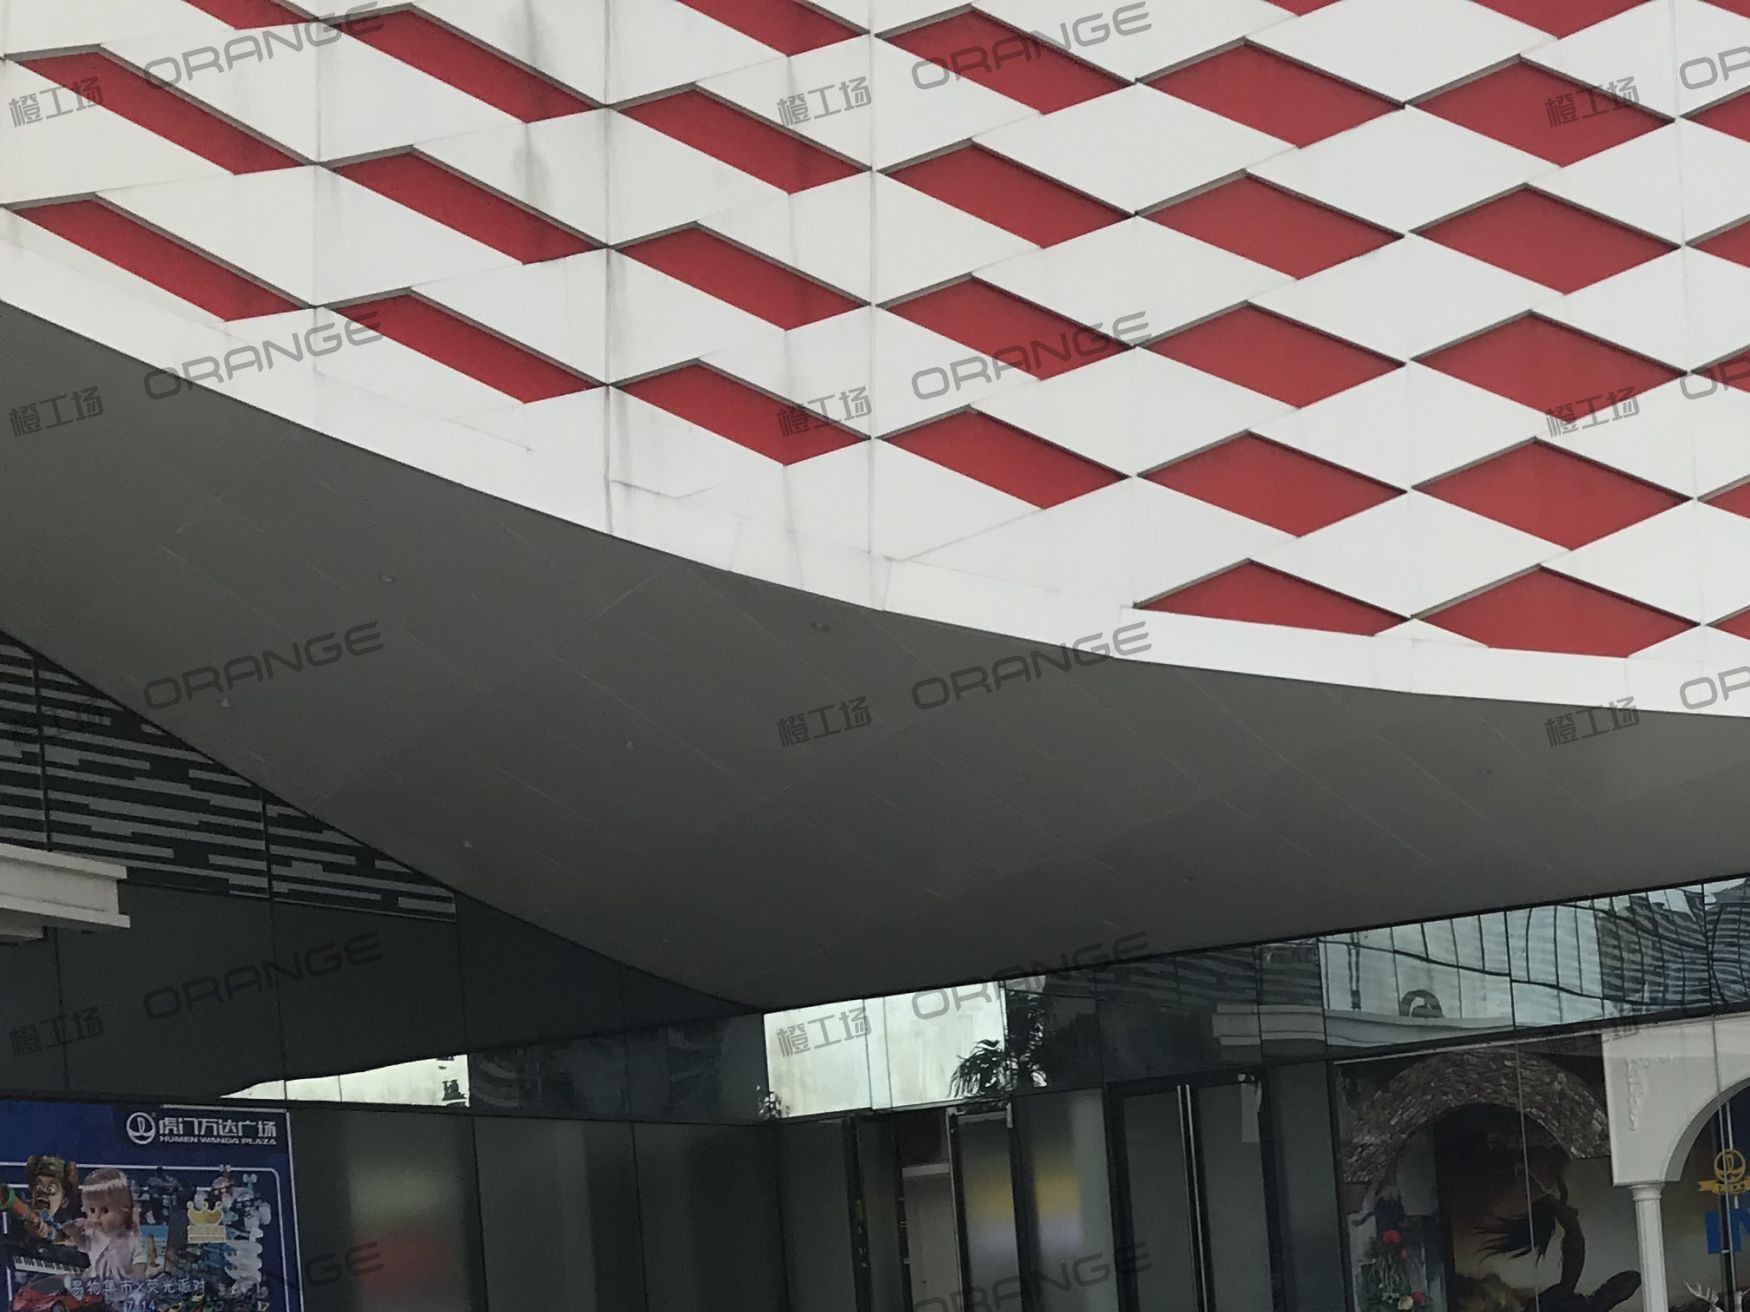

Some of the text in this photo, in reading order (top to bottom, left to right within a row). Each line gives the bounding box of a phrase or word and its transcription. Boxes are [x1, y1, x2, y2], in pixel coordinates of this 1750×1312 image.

[159, 1117, 277, 1137] 虎门万达广场
[159, 1135, 277, 1145] HUMEN WANDA PLAZA
